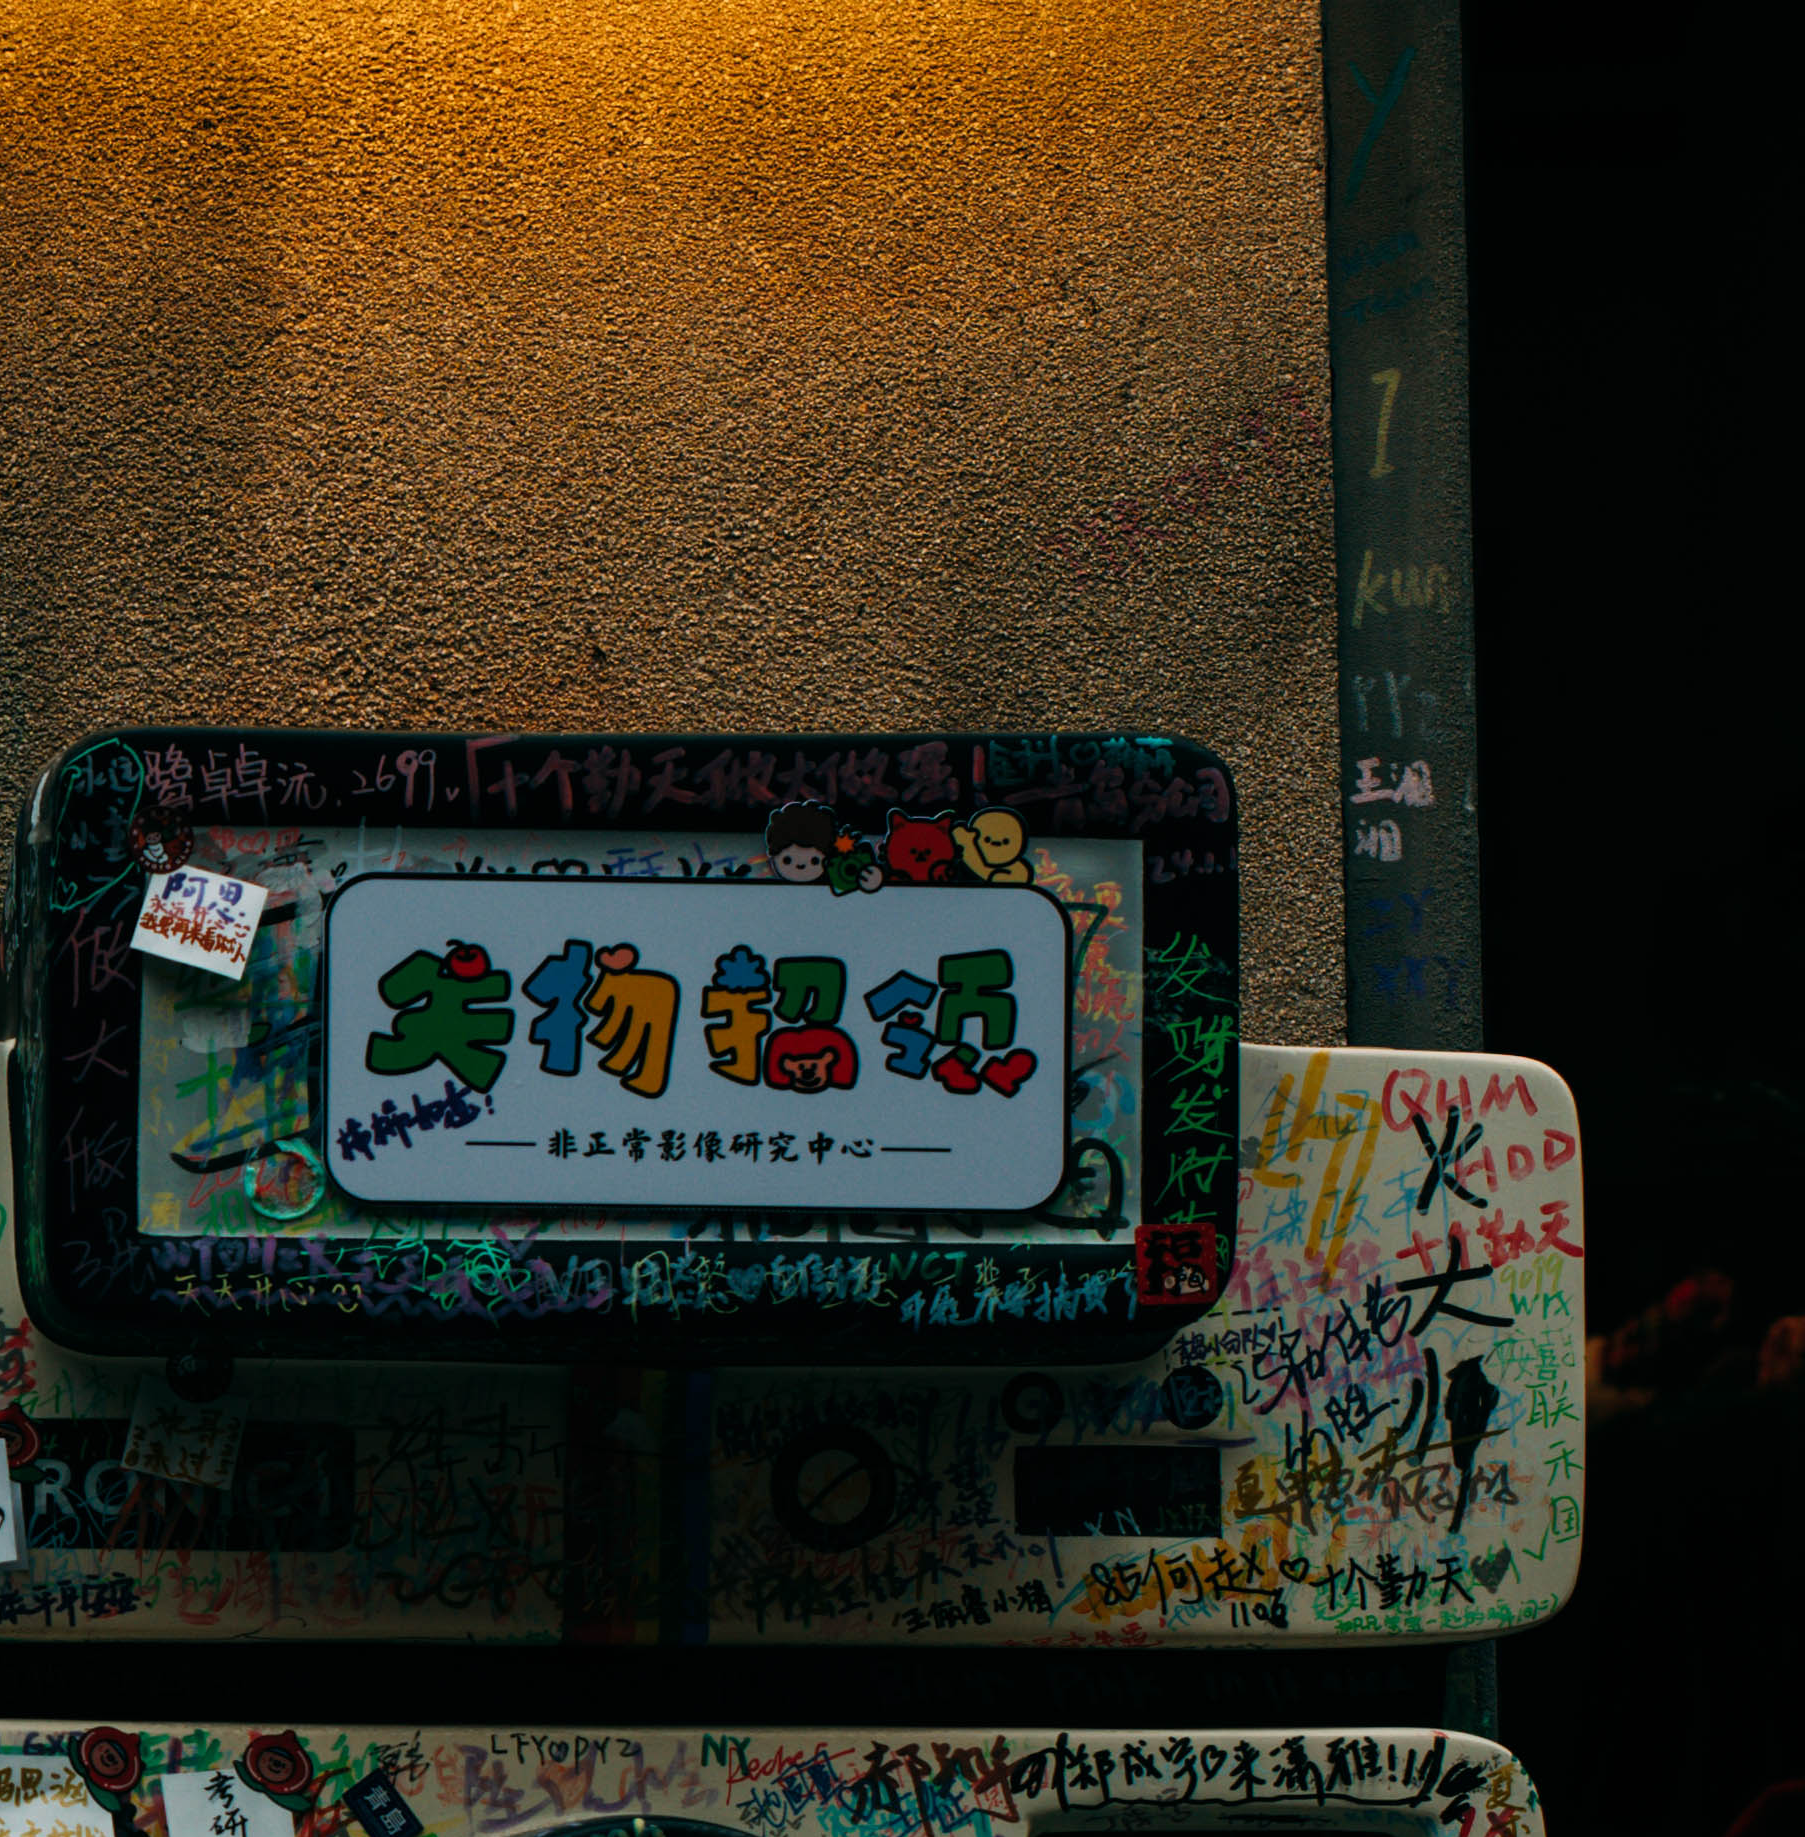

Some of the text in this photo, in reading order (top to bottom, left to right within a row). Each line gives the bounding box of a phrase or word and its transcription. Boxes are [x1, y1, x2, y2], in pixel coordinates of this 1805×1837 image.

[548, 1127, 874, 1166] 非正常影像研究中心
